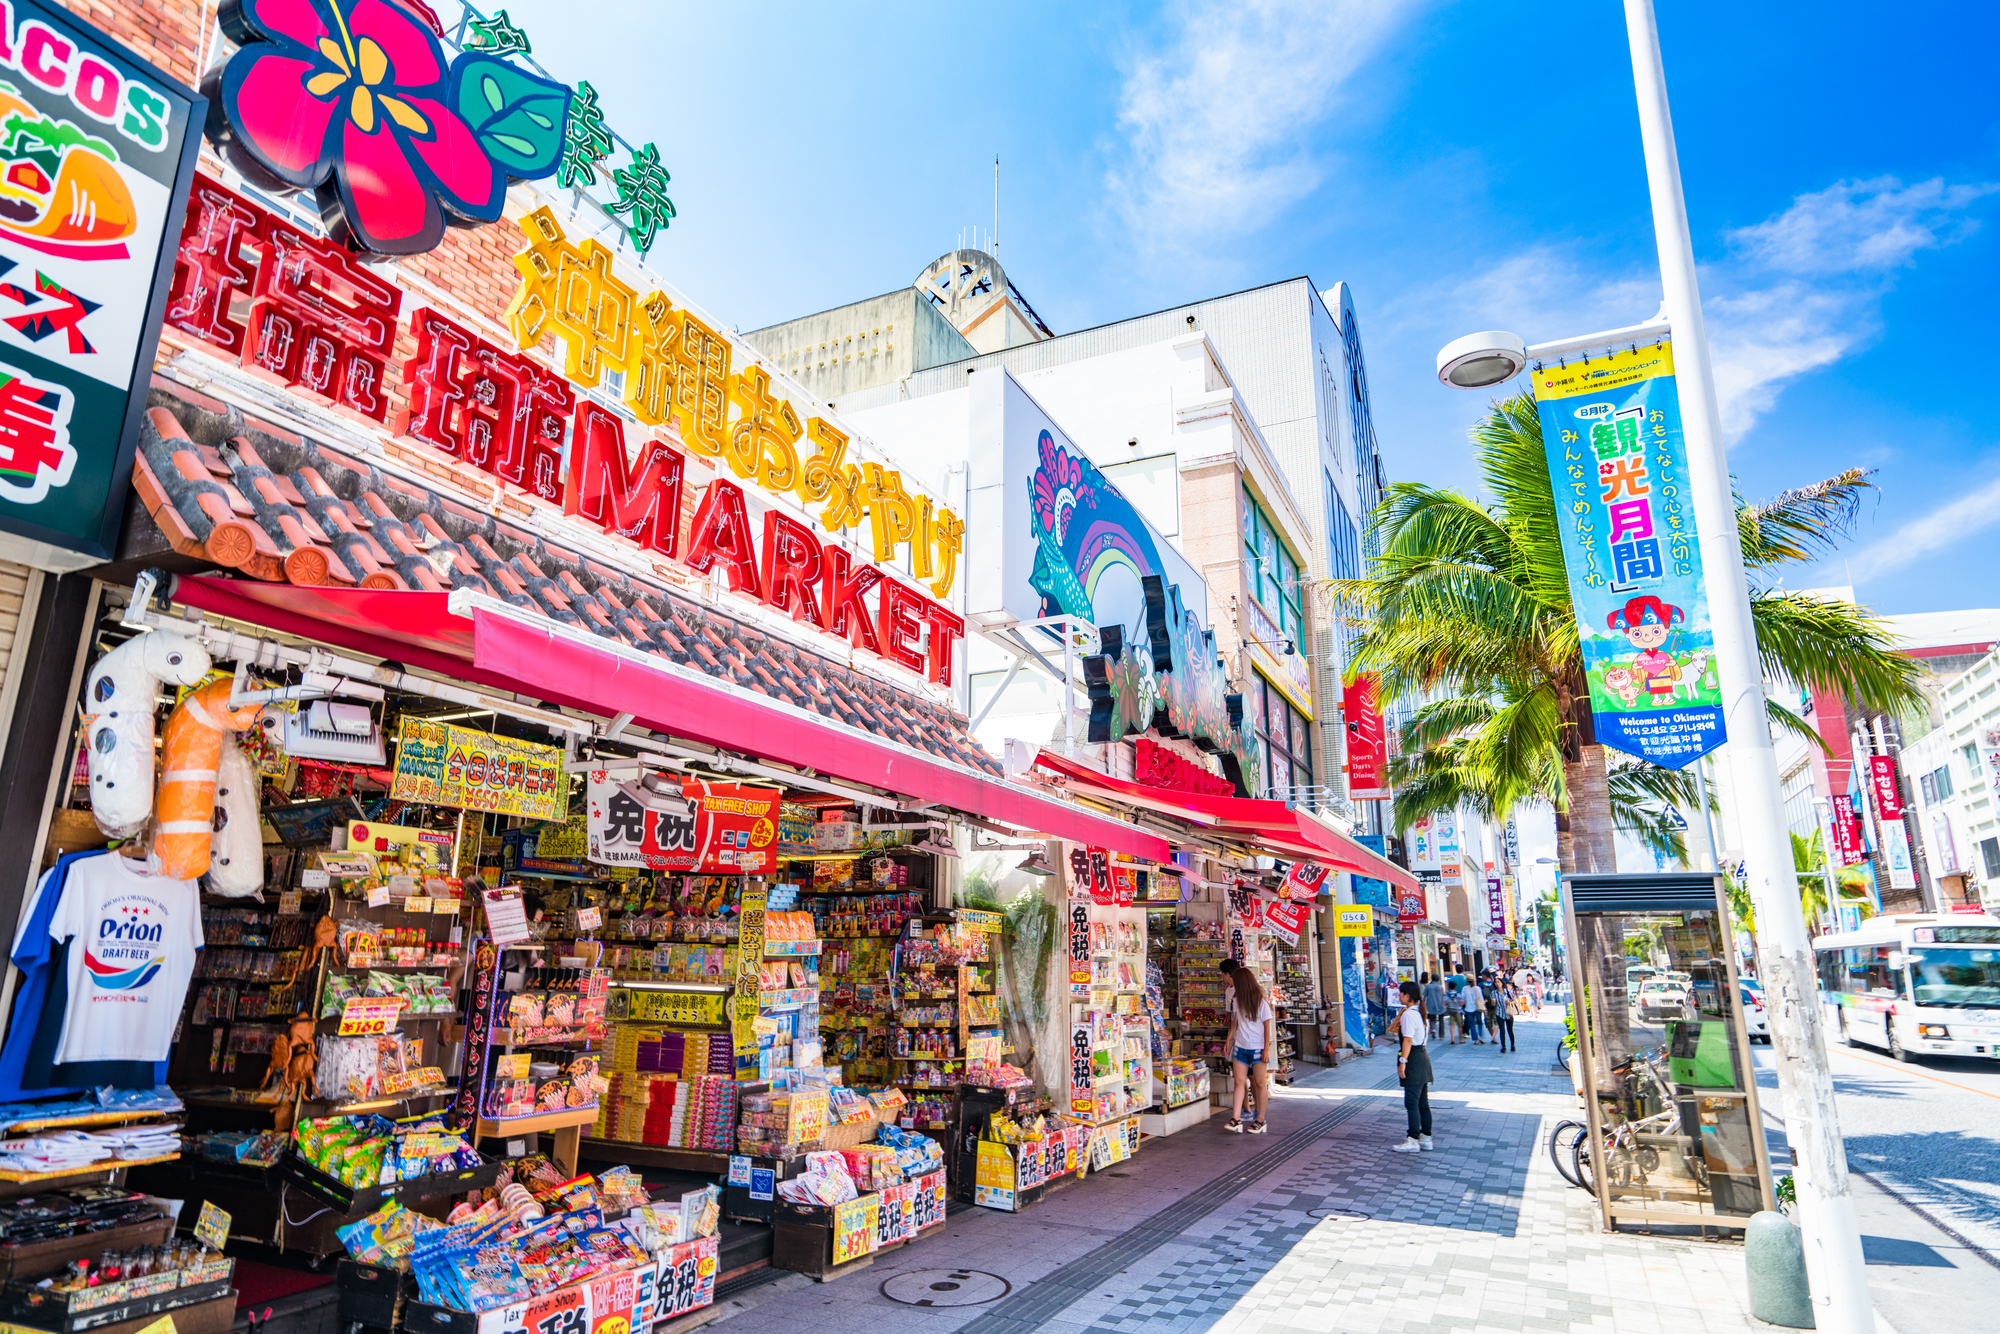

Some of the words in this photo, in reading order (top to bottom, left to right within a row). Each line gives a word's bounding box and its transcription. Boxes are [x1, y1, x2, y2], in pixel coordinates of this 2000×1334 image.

[1554, 377, 1575, 387] 沖縄県
[503, 205, 966, 599] 沖縄おみやげ
[1649, 408, 1691, 576] おもてなしの心を大切に
[1619, 716, 1658, 726] Welcome
[1660, 716, 1671, 724] to
[1673, 712, 1716, 723] Okinawa
[405, 721, 446, 745] 隣の店
[404, 742, 444, 761] 琉球
[400, 757, 444, 779] MARKET
[448, 746, 557, 797] 全国送料無料
[396, 777, 441, 800] 2号店と
[604, 790, 699, 848] 免税
[704, 797, 723, 811] TAX
[723, 799, 744, 813] FREE
[745, 801, 771, 816] SHOP
[751, 835, 769, 845] OFF
[100, 916, 163, 942] Orion
[1342, 913, 1366, 921] りらくる
[1071, 905, 1090, 962] 免税
[102, 948, 129, 959] DRAFT
[130, 949, 150, 960] BEER
[737, 909, 763, 995] 超お買い得
[343, 1020, 385, 1033] ¥160
[653, 1009, 698, 1022] ちんすこう
[1073, 1029, 1091, 1089] 免税
[979, 1155, 1013, 1174] 免税店
[1020, 1152, 1038, 1187] 免税
[914, 1185, 936, 1228] 免税
[846, 1226, 871, 1259] ¥370
[654, 1258, 698, 1318] 免税
[503, 1300, 550, 1324] Tax-Free
[554, 1292, 577, 1308] Shop
